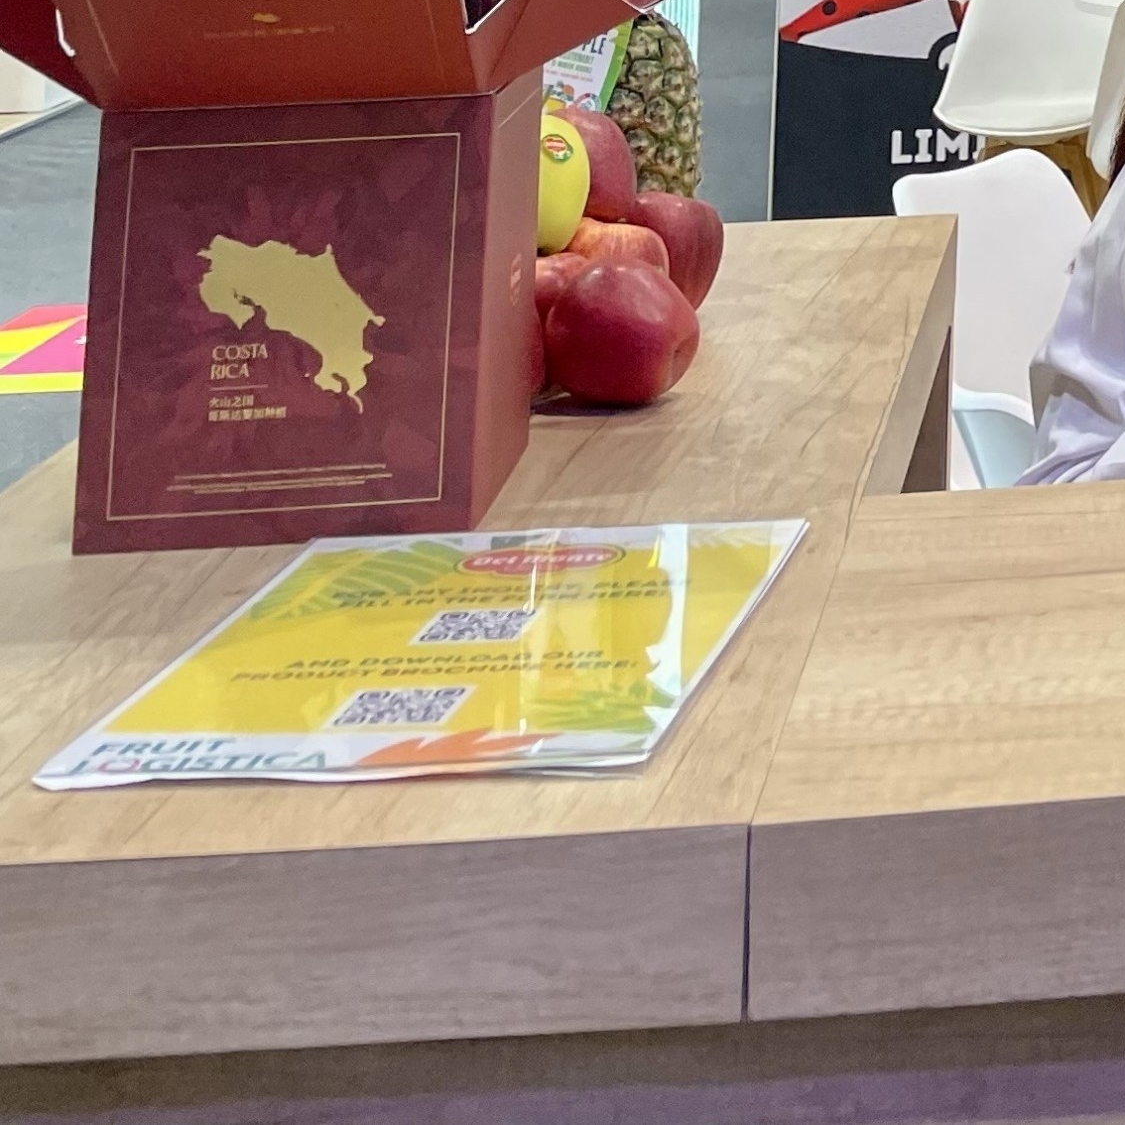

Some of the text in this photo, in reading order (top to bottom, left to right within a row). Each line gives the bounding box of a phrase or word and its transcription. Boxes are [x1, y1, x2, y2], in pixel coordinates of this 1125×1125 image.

[211, 342, 269, 361] COSTA
[210, 362, 250, 380] RICA
[472, 554, 520, 568] Del
[404, 596, 434, 606] IN
[445, 594, 490, 605] THE
[286, 649, 605, 669] AND DOWNLOAD OUR
[230, 668, 372, 682] PRODUCT
[380, 662, 543, 677] BROCHURE
[91, 737, 237, 757] FRUIT
[68, 750, 327, 774] LOGISTICA
